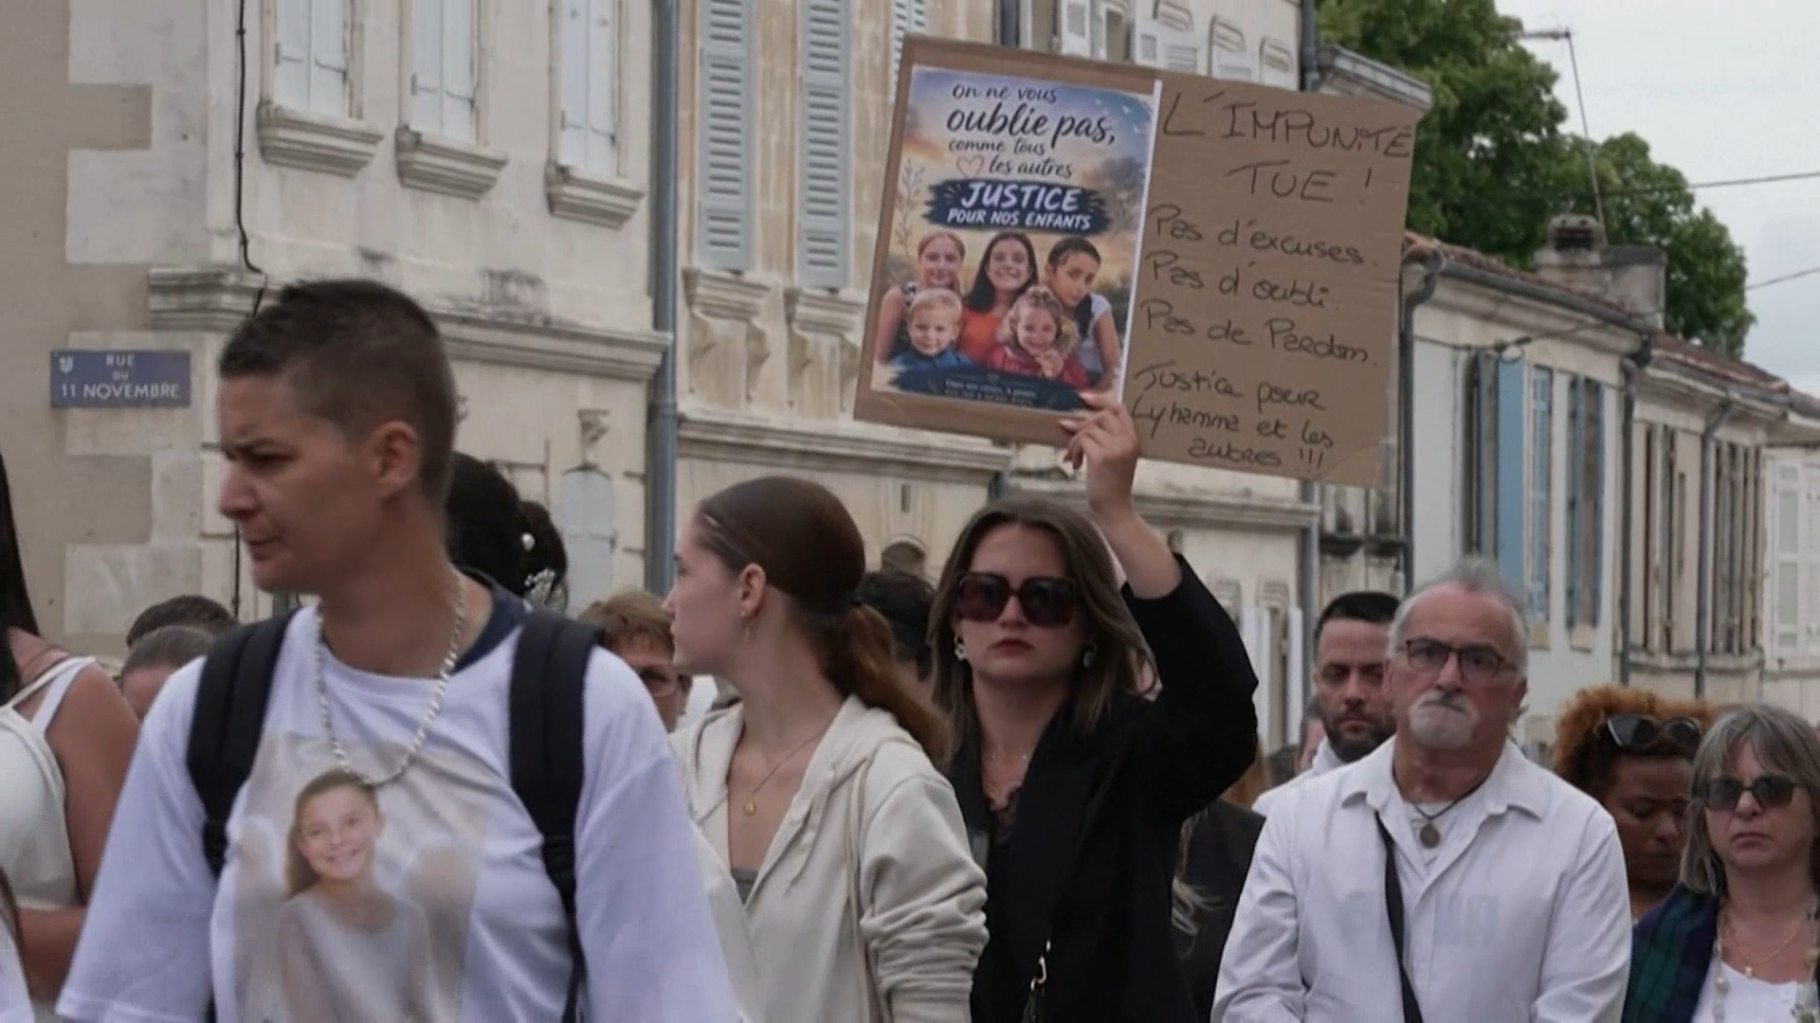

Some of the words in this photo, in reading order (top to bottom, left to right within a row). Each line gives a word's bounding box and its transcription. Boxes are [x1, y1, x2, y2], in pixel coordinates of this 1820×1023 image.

[985, 84, 1010, 99] ne
[1017, 86, 1058, 104] vous
[946, 102, 1049, 137] oublie
[1050, 113, 1116, 150] pas,
[949, 139, 1005, 152] comme
[1013, 137, 1046, 156] tous
[989, 154, 1013, 176] les
[1017, 159, 1073, 178] autres
[1225, 159, 1336, 203] TUE
[1360, 166, 1372, 204] !
[960, 182, 1082, 211] JUSTICE
[947, 208, 986, 225] POUR
[990, 211, 1020, 226] NOS
[1025, 212, 1092, 230] ENFANTS
[1149, 203, 1203, 241] Pas
[1145, 250, 1204, 289] Pas
[1140, 298, 1196, 336] Pas
[1207, 318, 1253, 345] de
[106, 354, 135, 367] RUE
[61, 383, 76, 398] 11
[83, 382, 179, 399] NOVEMBRE
[1133, 360, 1245, 398] Justice
[1256, 418, 1287, 439] et
[1301, 419, 1334, 449] les
[1299, 447, 1324, 473] !!!
